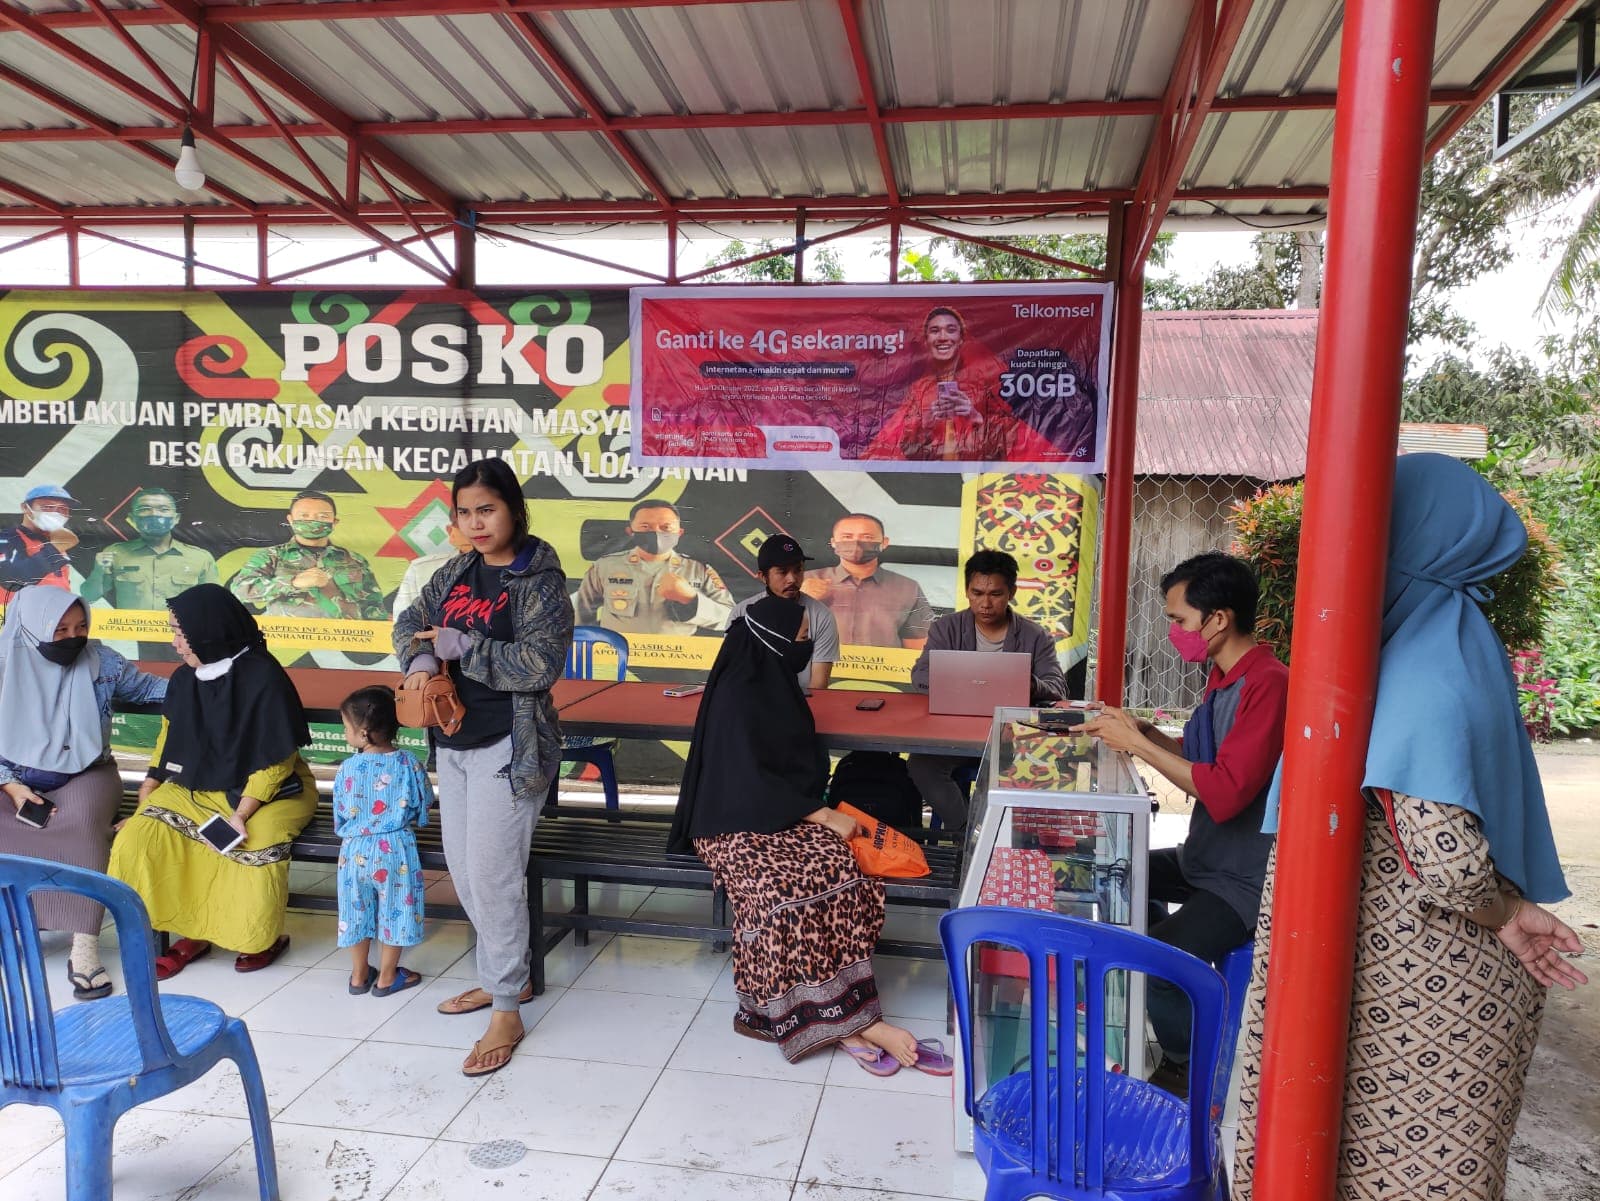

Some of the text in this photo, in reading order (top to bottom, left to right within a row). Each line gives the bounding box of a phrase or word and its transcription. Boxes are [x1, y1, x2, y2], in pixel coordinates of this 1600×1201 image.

[1012, 302, 1094, 318] Telkomsel
[655, 329, 905, 354] Ganti ke 4G sekarang!
[280, 323, 604, 386] POSKO
[1017, 349, 1060, 358] Dapatkan
[1010, 360, 1067, 369] kuota hingga
[706, 365, 850, 377] Internetan semakin cepat dan murah
[1000, 374, 1076, 397] 30GB
[184, 402, 374, 430] PEMBATASAN
[381, 405, 523, 433] KEGIATAN
[532, 408, 632, 436] MASYA
[149, 441, 221, 467] DESA
[229, 443, 384, 472] BAKUNGAN
[583, 451, 640, 479] LOA
[98, 625, 133, 633] KEPALA
[261, 624, 300, 632] KAPTEN
[333, 628, 375, 636] WIDODO
[340, 635, 372, 643] JANAN
[632, 642, 663, 650] YASIR
[668, 652, 703, 660] JANAN
[818, 1005, 843, 1018] DIOR
[776, 1014, 799, 1037] DIOR
